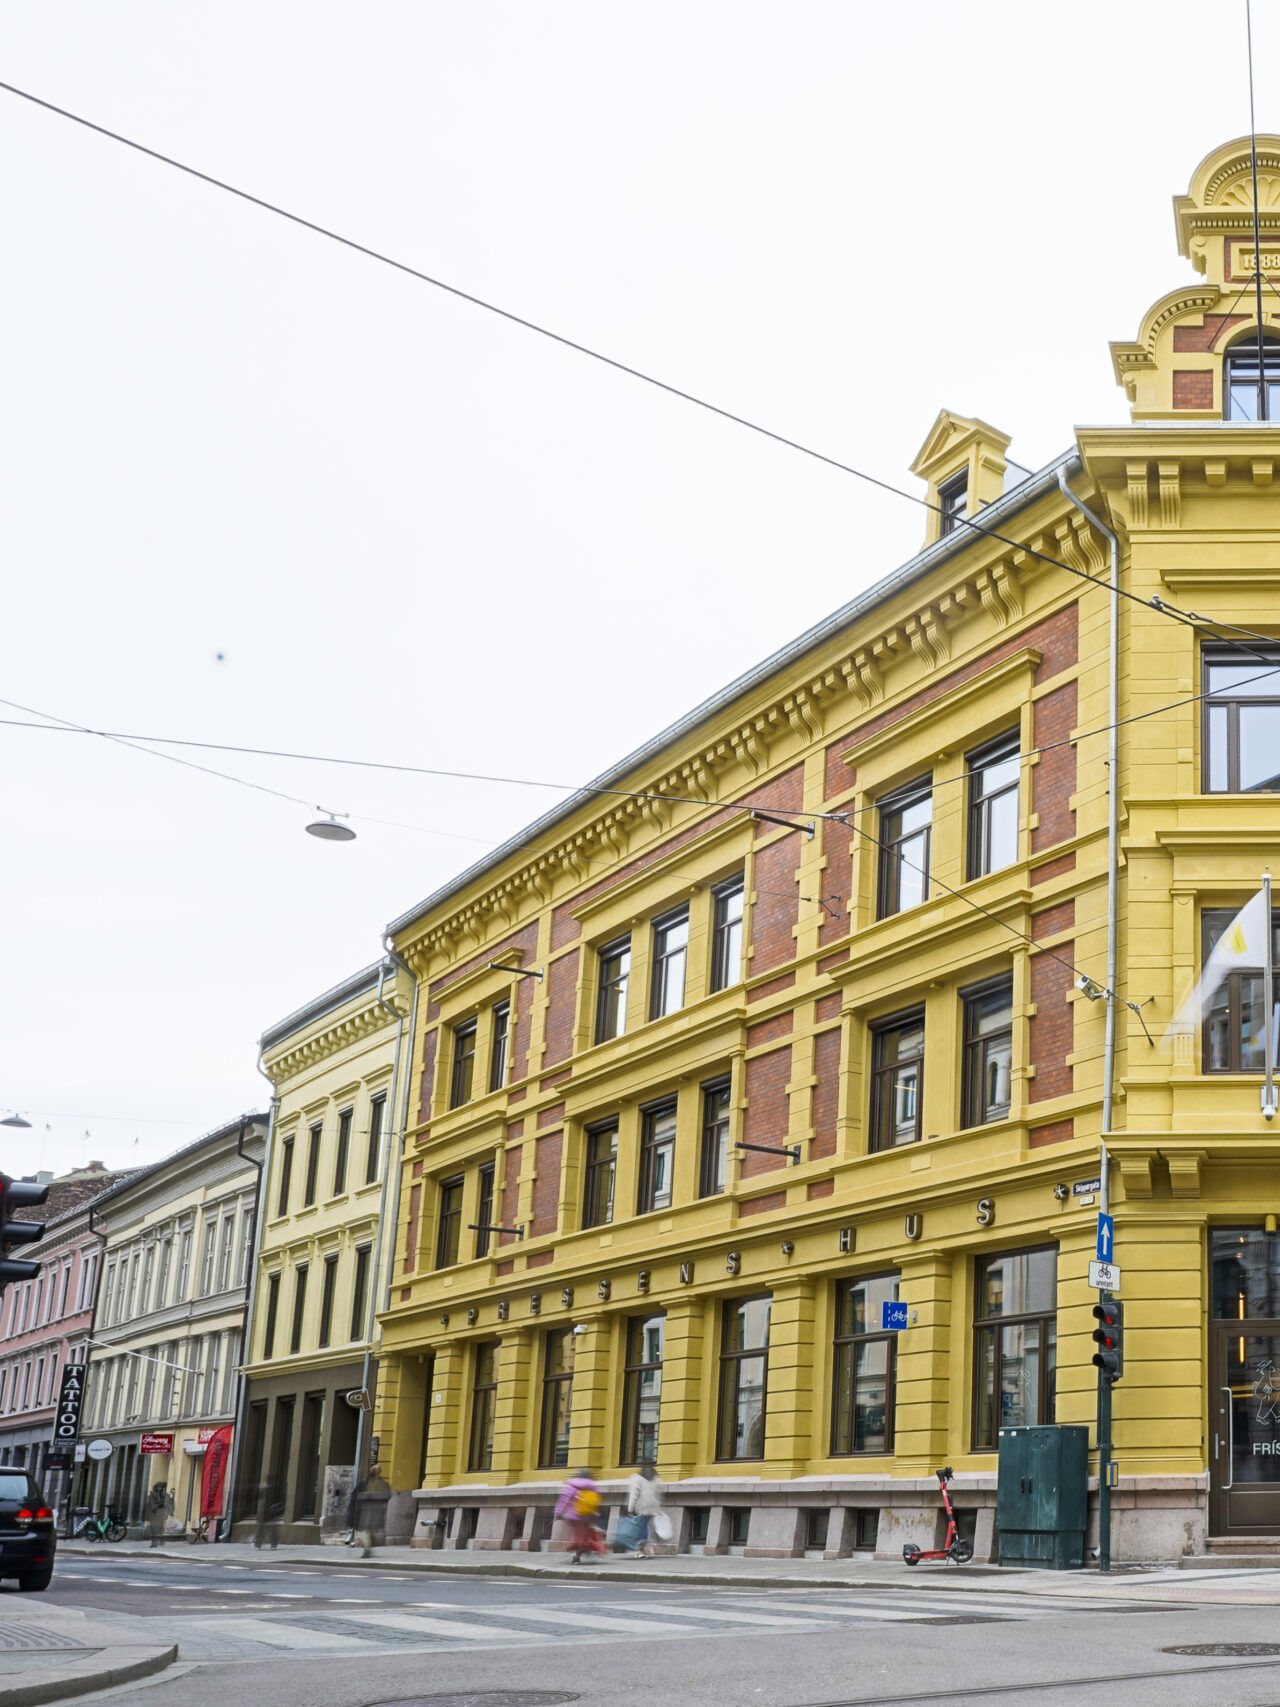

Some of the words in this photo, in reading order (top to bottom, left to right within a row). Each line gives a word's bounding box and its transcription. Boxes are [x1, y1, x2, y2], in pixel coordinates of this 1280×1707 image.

[467, 1251, 741, 1326] PRESSENS
[839, 1198, 996, 1254] HUS
[59, 1366, 83, 1436] TATTOO
